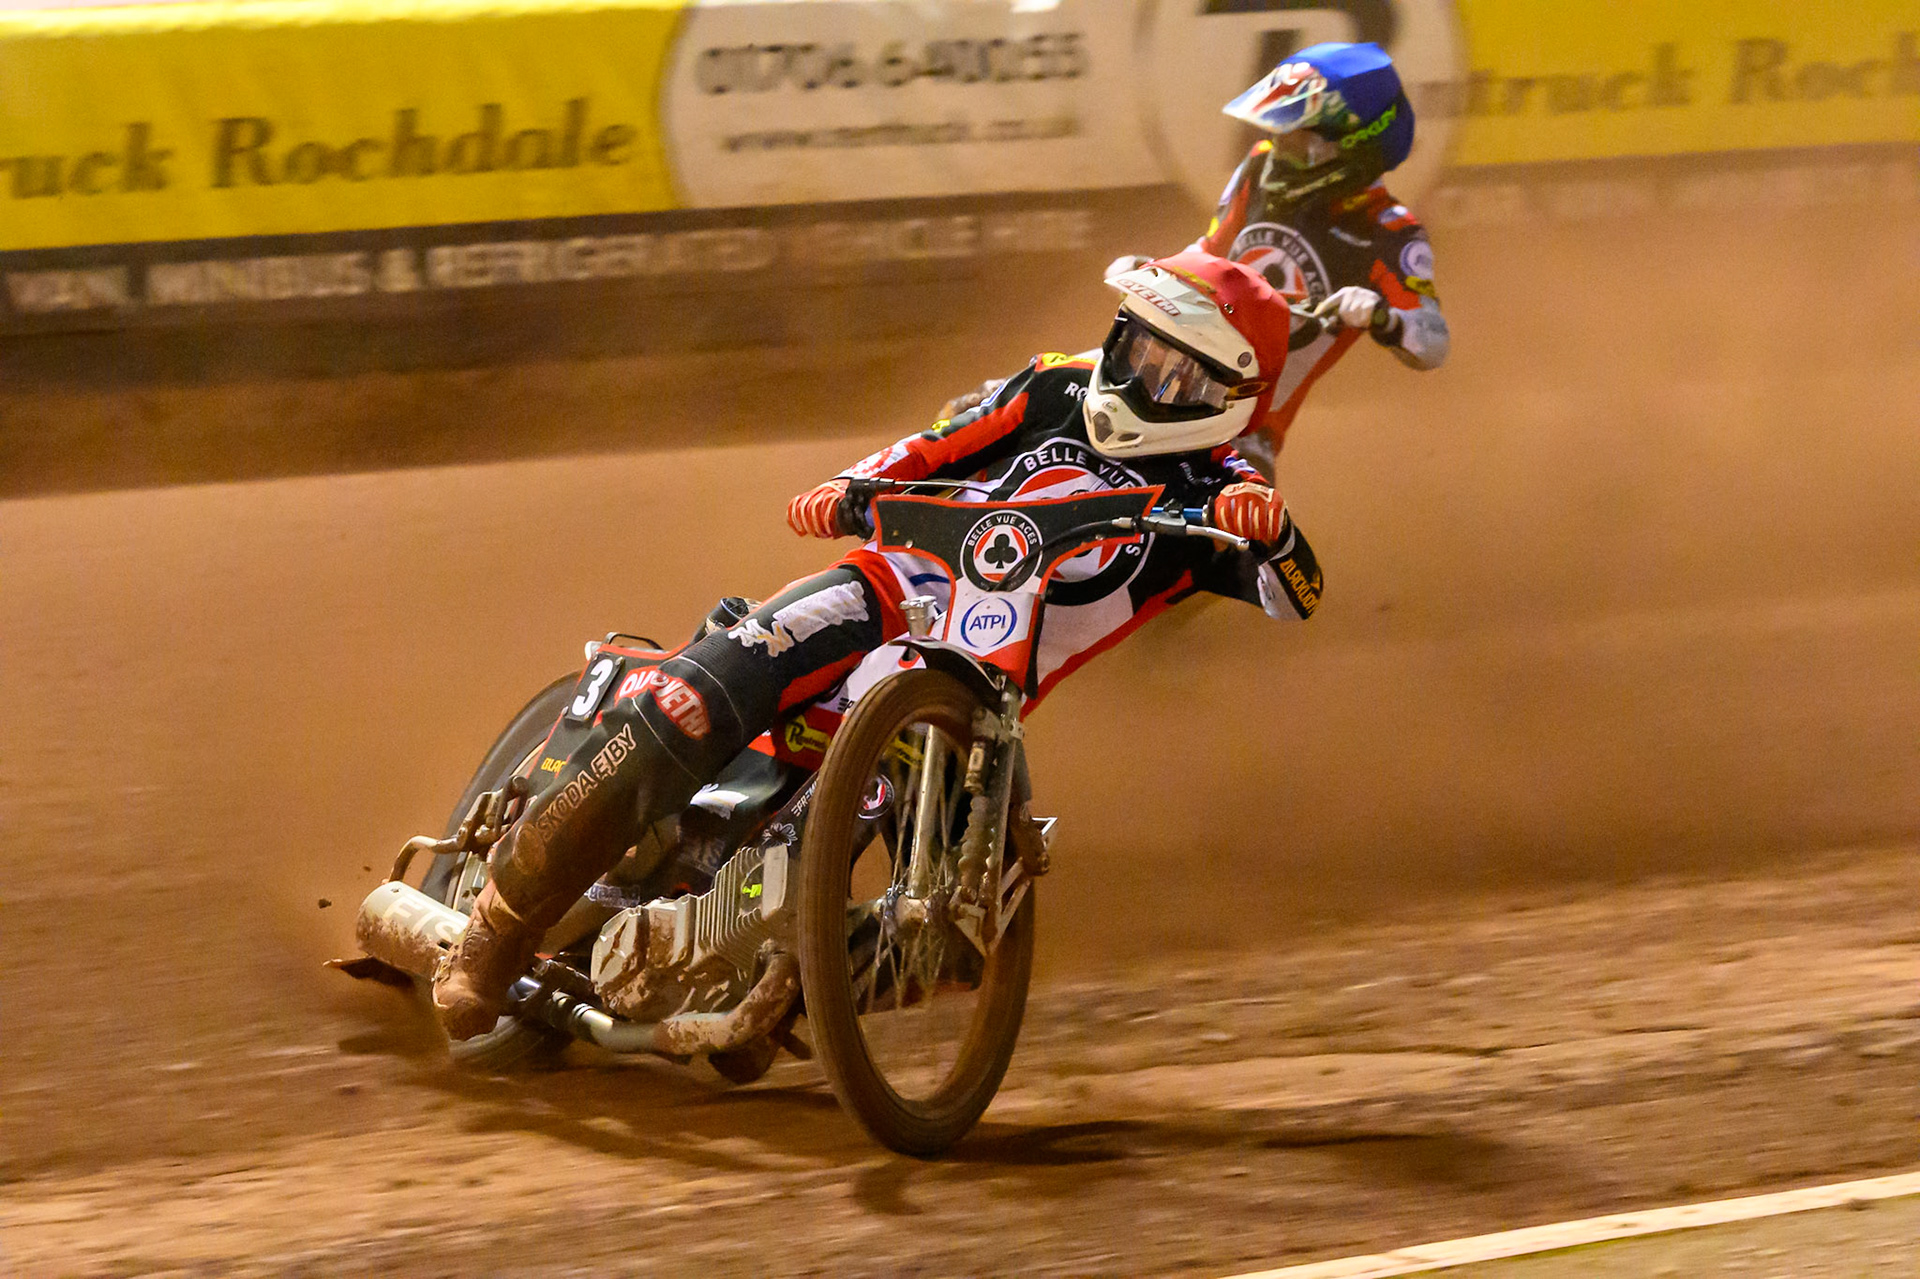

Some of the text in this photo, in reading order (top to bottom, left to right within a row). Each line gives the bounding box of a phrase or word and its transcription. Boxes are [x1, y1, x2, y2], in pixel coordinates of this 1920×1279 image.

[0, 97, 637, 198] uck Rochdale
[1023, 447, 1088, 472] BELLE
[967, 514, 1038, 547] BELLE VUE ACES
[969, 614, 1006, 631] ATPI
[571, 659, 613, 716] 3
[536, 769, 599, 842] SKODA
